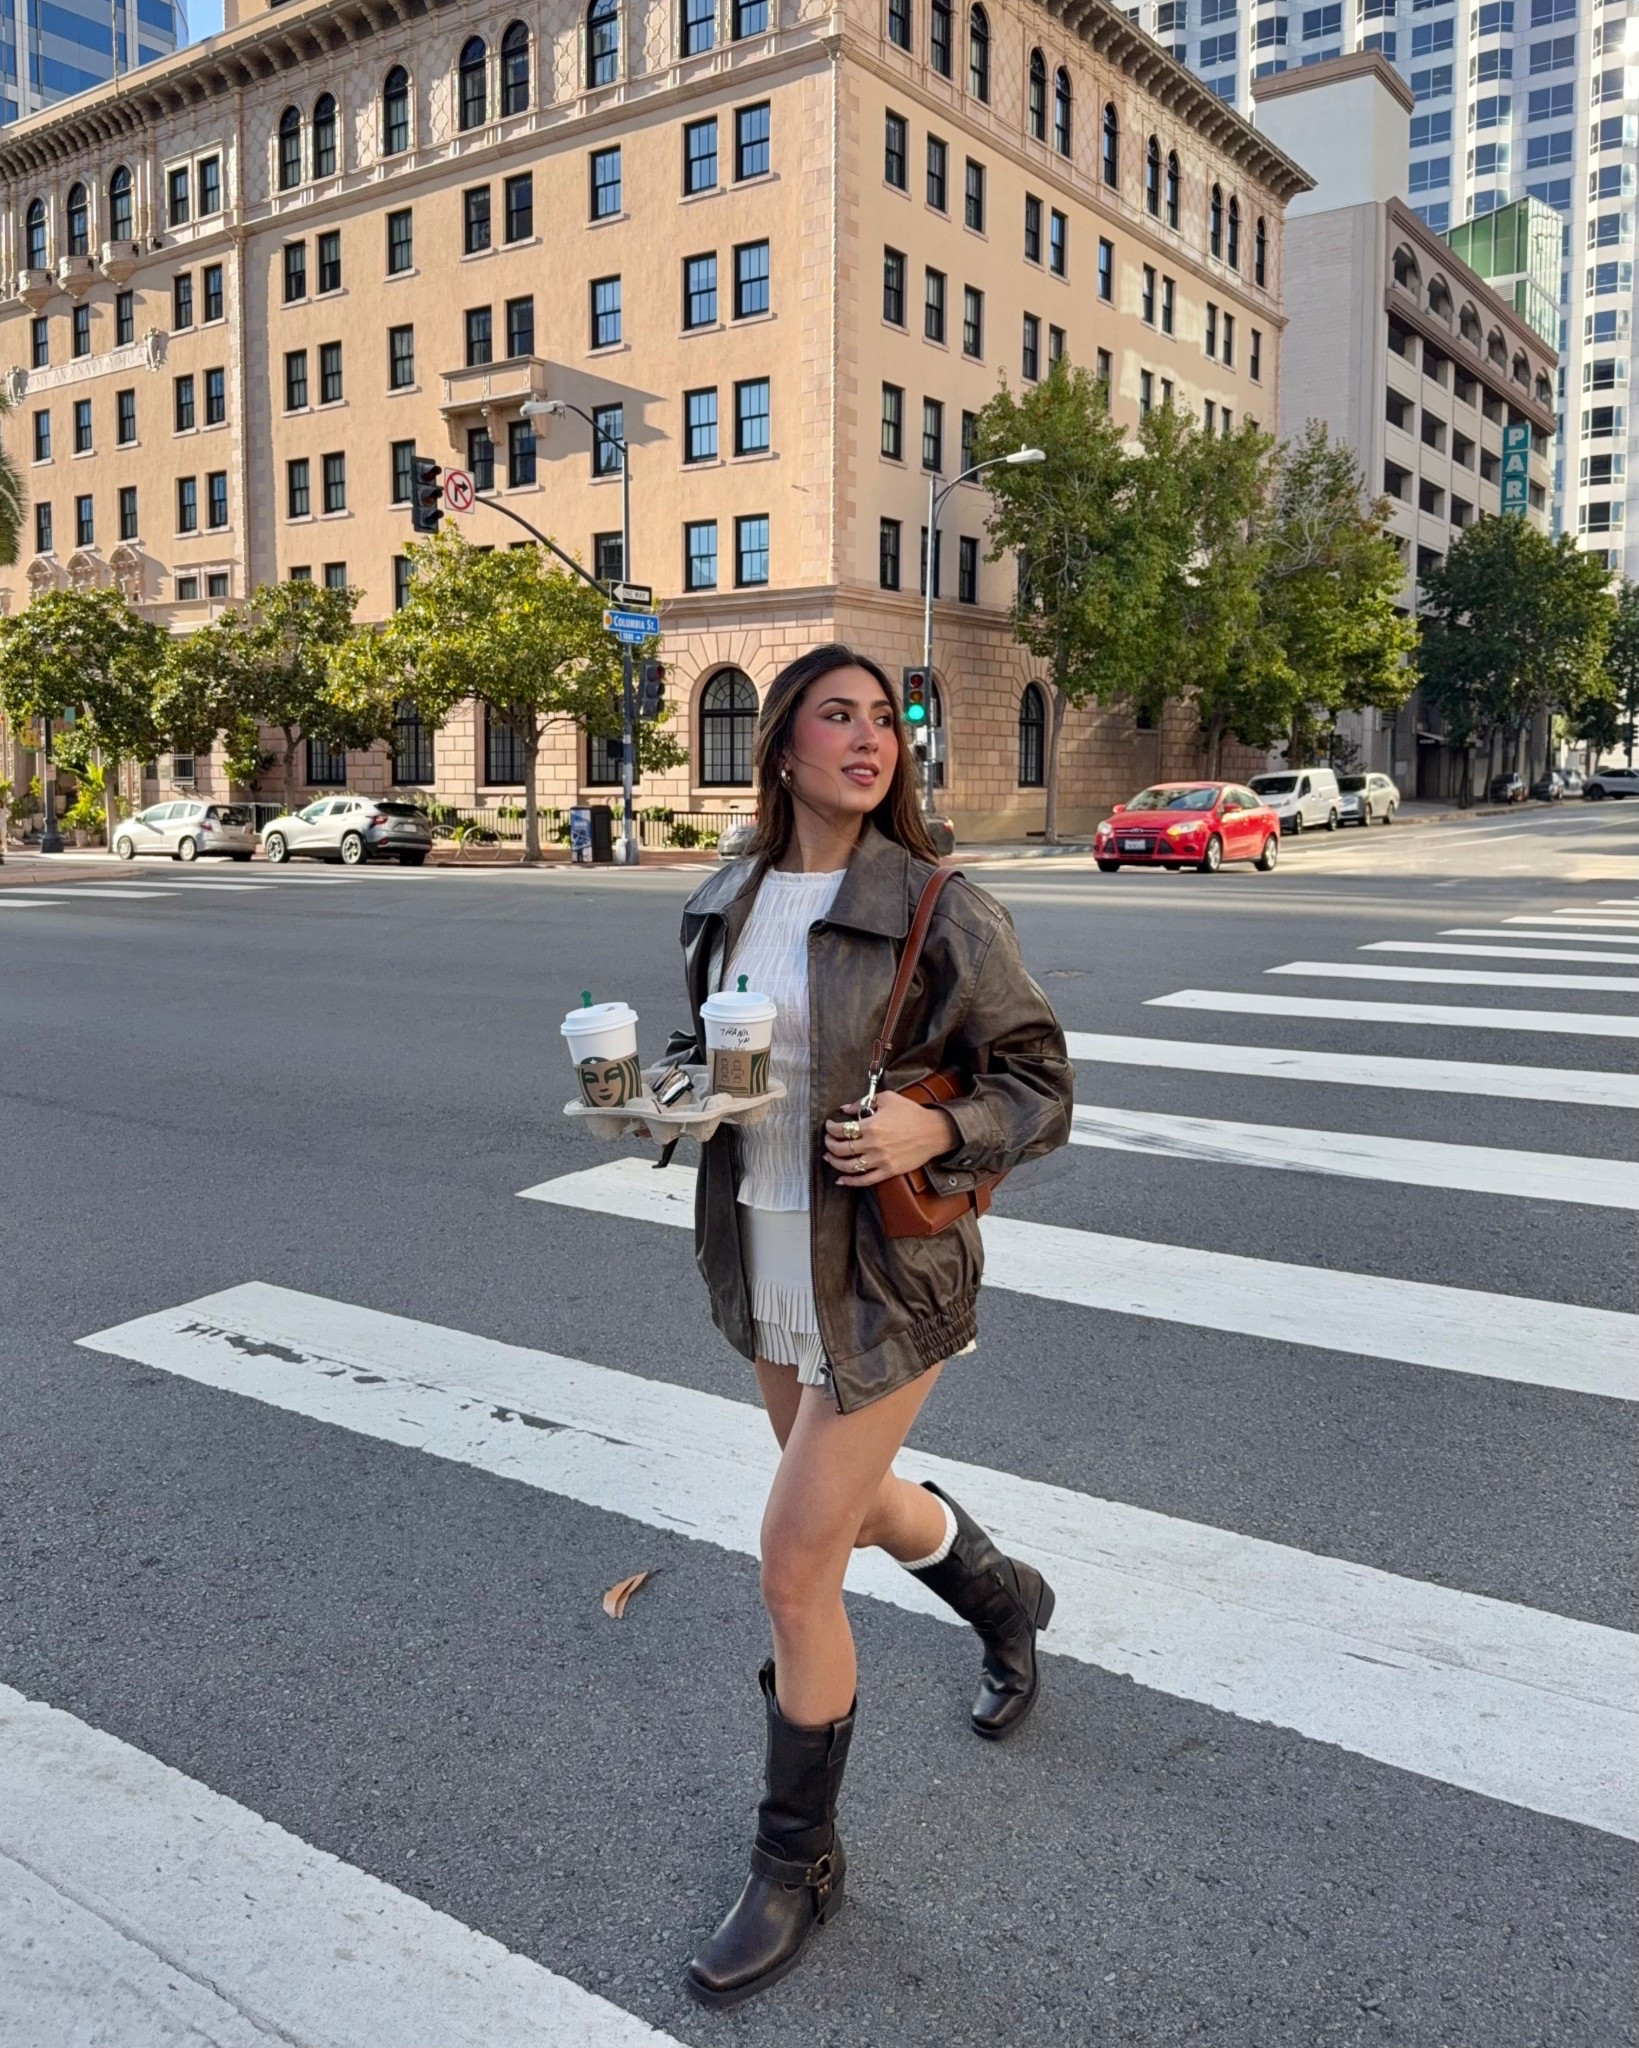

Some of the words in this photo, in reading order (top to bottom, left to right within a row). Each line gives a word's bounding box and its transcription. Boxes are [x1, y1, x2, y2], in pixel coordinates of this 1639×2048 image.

[77, 358, 104, 378] NAVY
[623, 589, 634, 598] ONE
[635, 591, 646, 600] WAY
